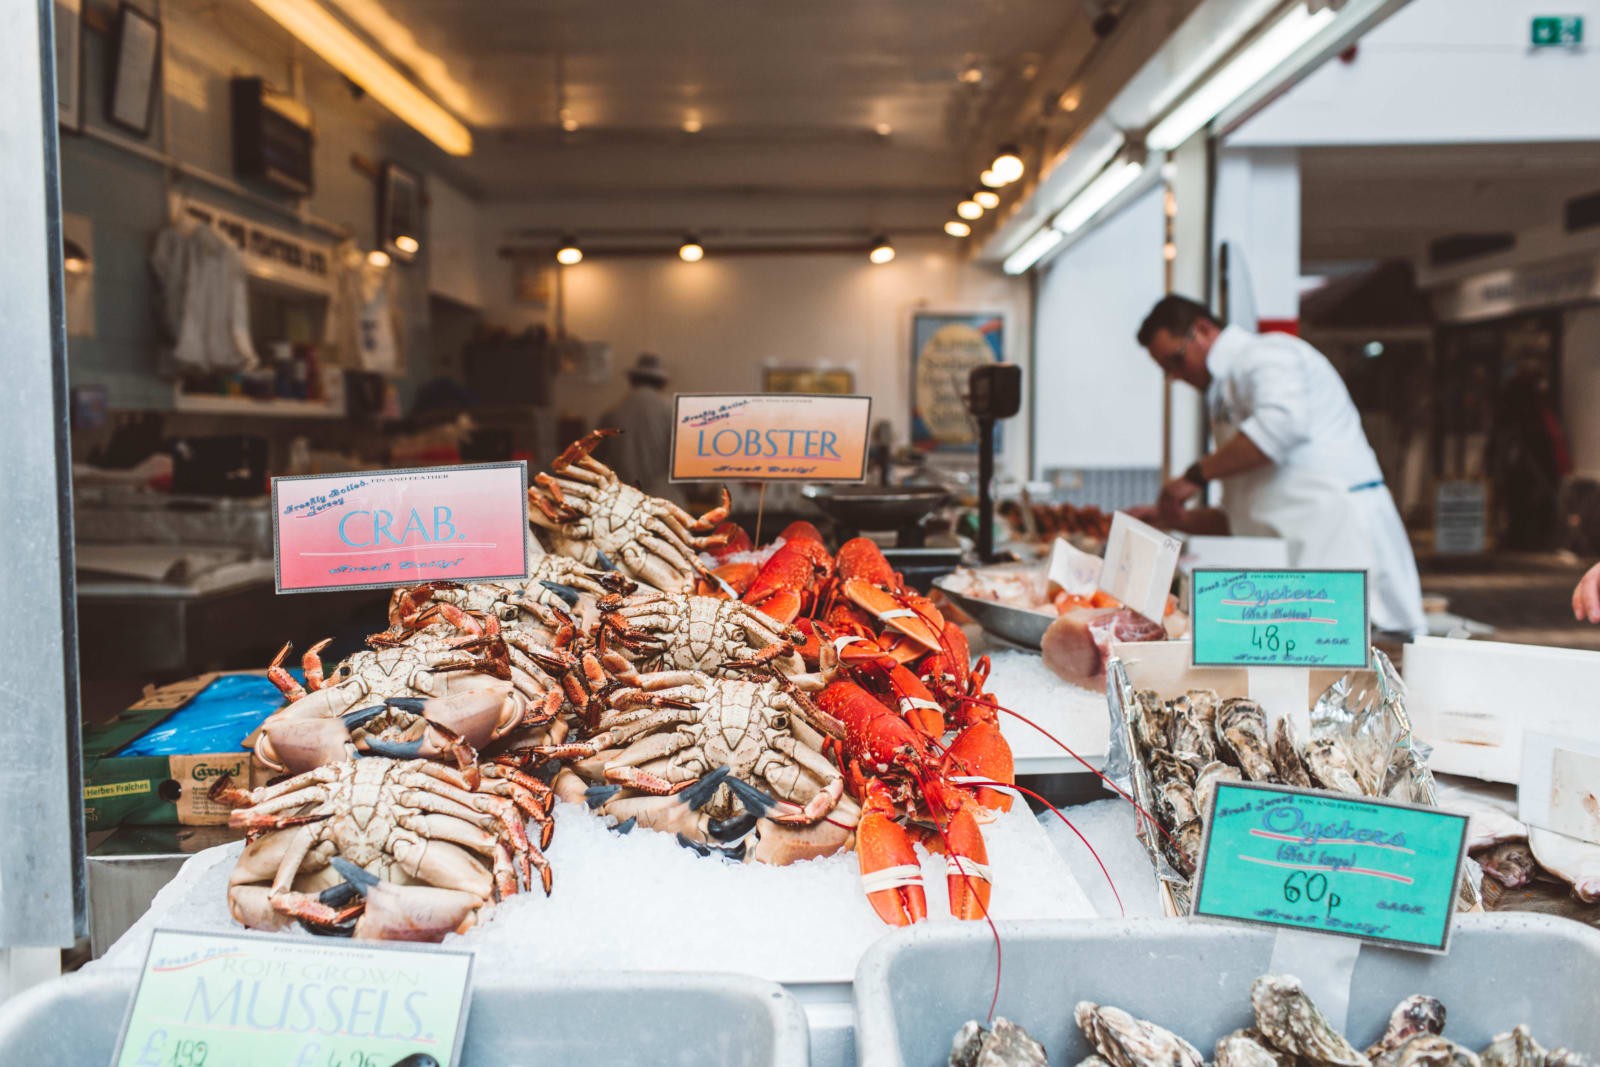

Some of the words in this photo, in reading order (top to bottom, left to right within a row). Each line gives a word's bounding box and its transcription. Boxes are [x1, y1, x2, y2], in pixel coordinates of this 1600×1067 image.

[697, 429, 841, 458] LOBSTER
[337, 505, 466, 548] CRAB.
[328, 562, 391, 575] Fresh
[1227, 580, 1328, 608] Oysters
[86, 787, 115, 797] Herbes
[1262, 806, 1407, 847] Oysters
[1284, 870, 1341, 917] 60p
[221, 957, 293, 978] ROPE
[302, 963, 420, 986] GROWN
[183, 976, 437, 1041] MUSSELS.
